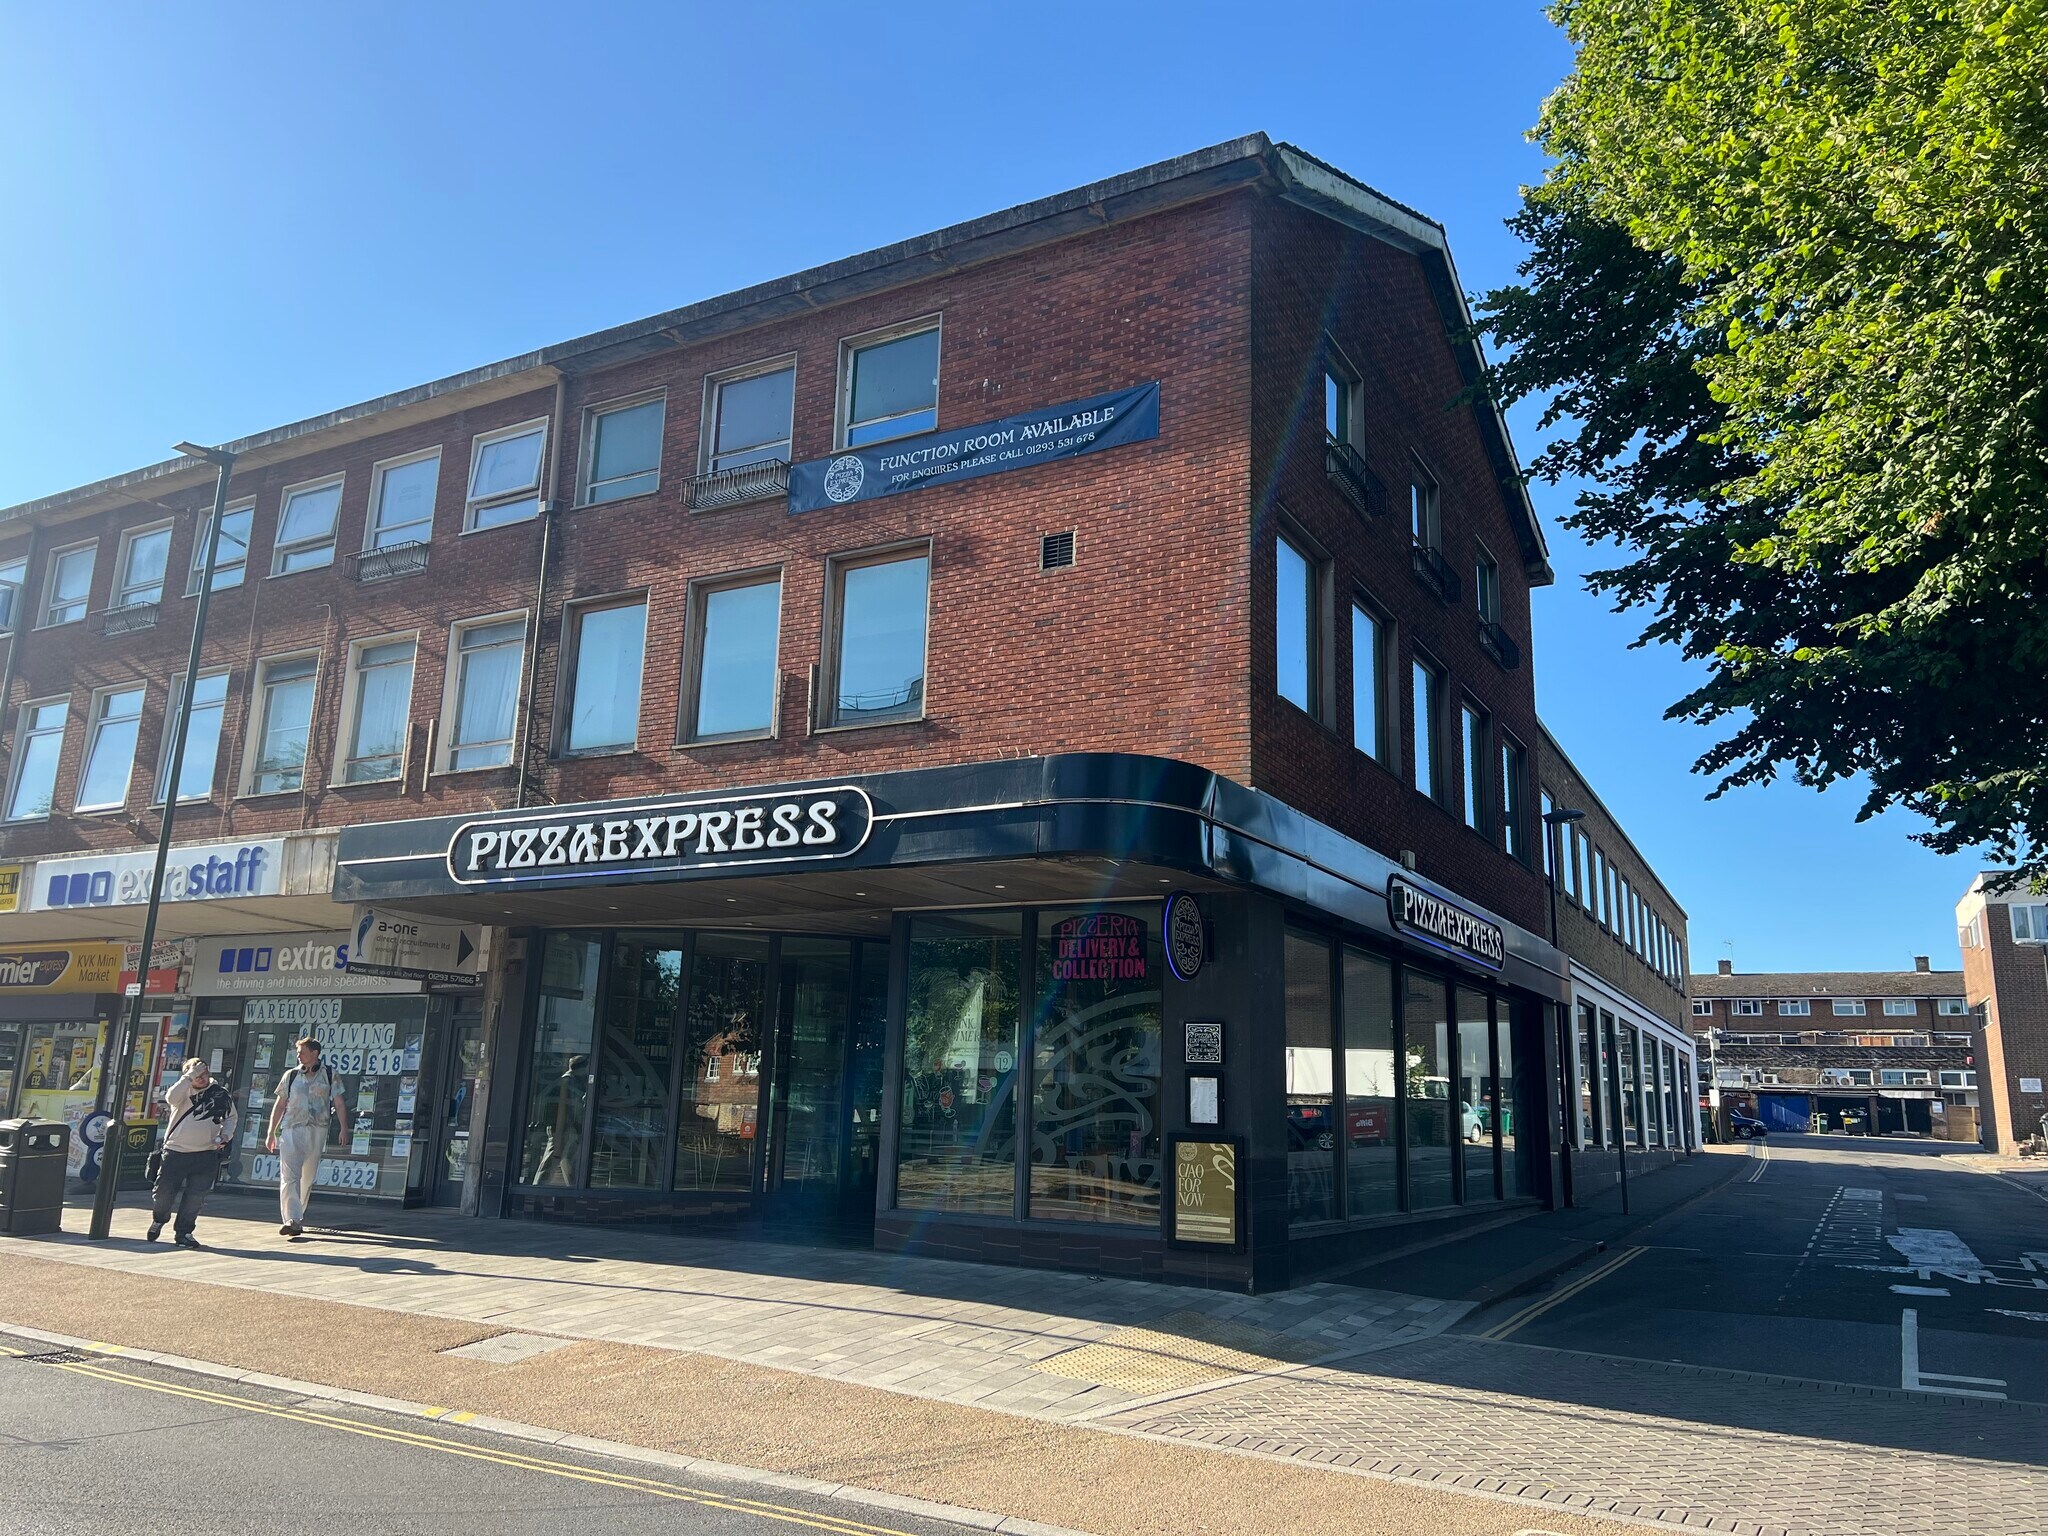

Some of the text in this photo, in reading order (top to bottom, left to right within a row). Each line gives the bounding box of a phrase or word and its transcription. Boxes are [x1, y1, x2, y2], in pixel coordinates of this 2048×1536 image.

[880, 407, 1114, 471] FUNCTION ROOM AVAILABLE
[891, 431, 1095, 483] FOR ENQUIRES PLEASE CALL 01293 531 678
[830, 474, 859, 486] EXPRESS
[835, 470, 854, 479] PIZZA
[466, 801, 839, 871] PIZZAEXPRESS
[117, 846, 264, 899] exrastaff
[378, 921, 418, 936] a-one
[1061, 915, 1139, 938] PIZZERIA
[1180, 921, 1196, 934] PIZZA
[1403, 885, 1503, 961] PIZZAEXPRESS
[376, 935, 398, 944] direct
[399, 938, 439, 950] recruitment
[1175, 930, 1200, 947] EXPRESS
[277, 940, 350, 971] extras
[1059, 937, 1140, 959] DELIVERY &
[77, 954, 118, 968] KVK Mini
[1053, 957, 1146, 980] COLLECTION
[0, 960, 40, 984] mier
[79, 970, 110, 982] Market
[428, 973, 448, 981] 01293
[216, 976, 231, 989] the
[233, 976, 264, 991] driving
[267, 976, 285, 988] and
[287, 975, 332, 988] industrial
[247, 1002, 340, 1019] WAREHOUSE
[317, 1027, 394, 1045] DRIVING
[321, 1053, 401, 1072] ASS2 £18
[129, 1134, 147, 1146] ups
[1178, 1162, 1205, 1179] CIAO
[1178, 1177, 1202, 1193] FOR
[1178, 1191, 1206, 1207] NOW
